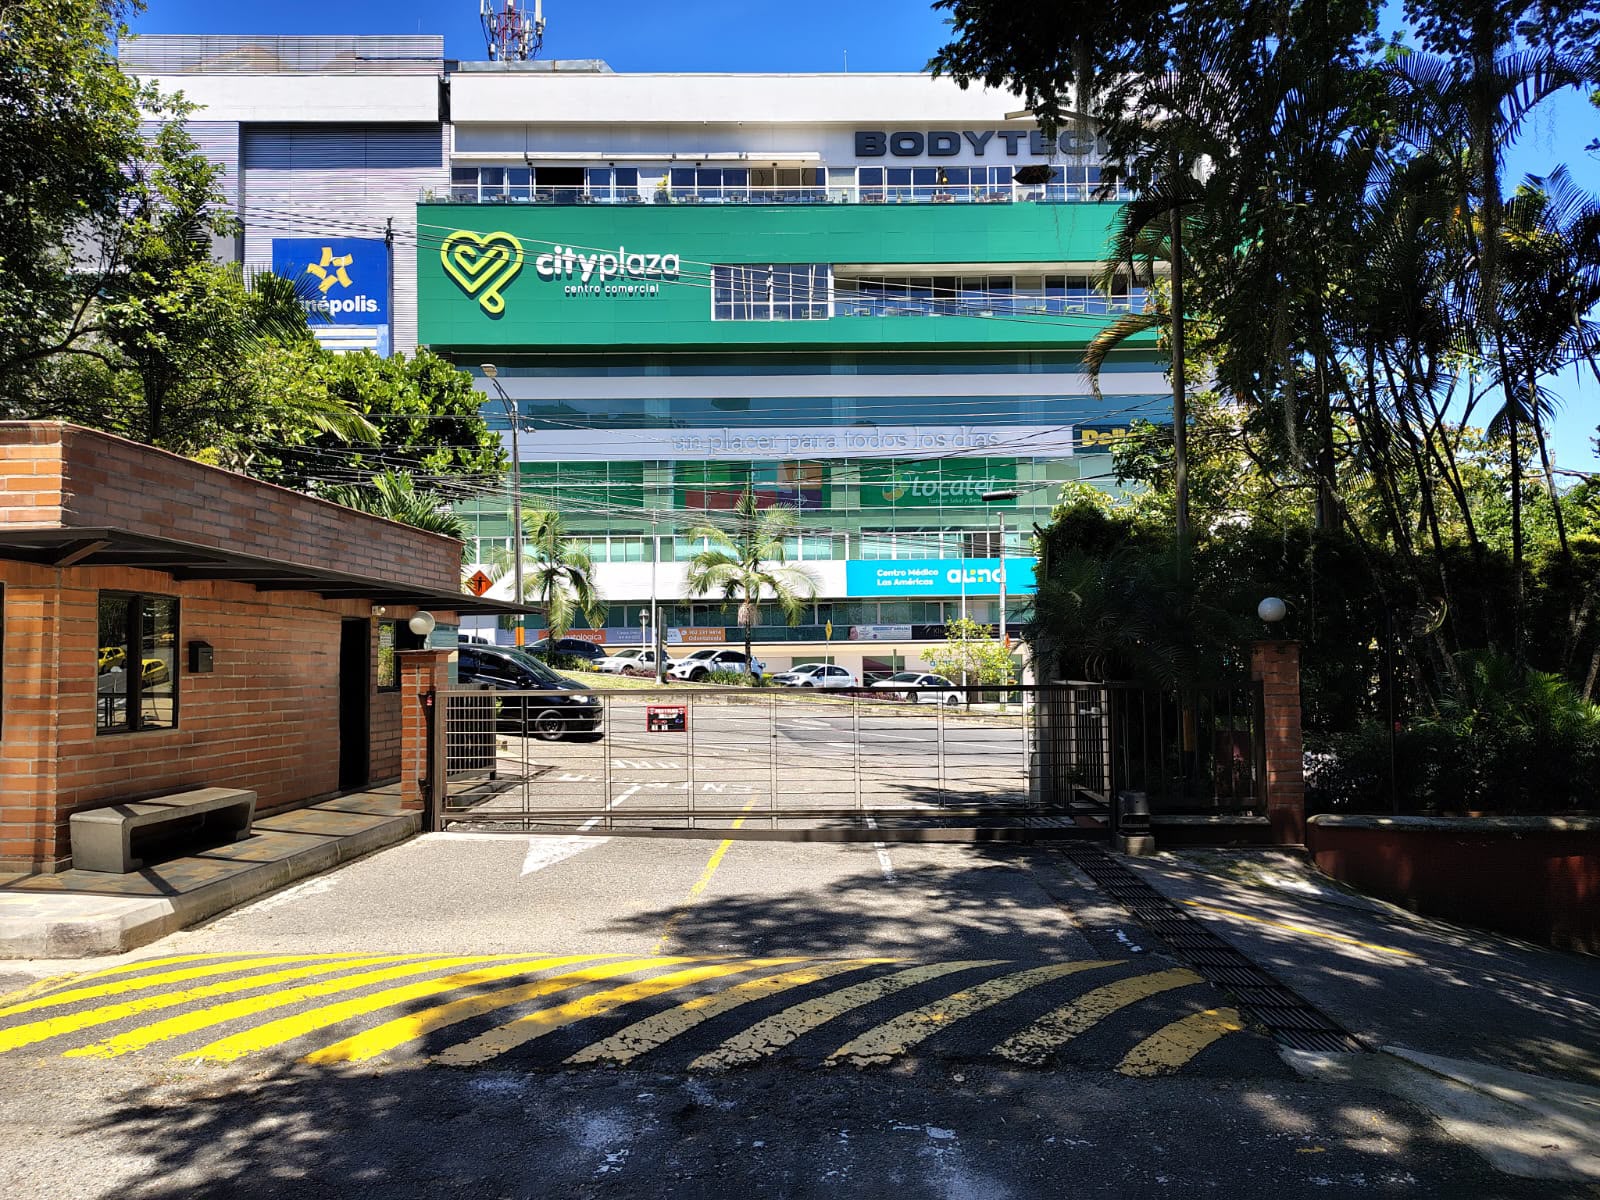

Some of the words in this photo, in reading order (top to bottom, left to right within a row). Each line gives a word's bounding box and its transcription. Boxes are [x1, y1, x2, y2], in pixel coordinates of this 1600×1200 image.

[536, 246, 680, 282] cityplaza
[564, 284, 600, 293] centro
[604, 284, 659, 293] comercial
[672, 433, 701, 450] un
[707, 428, 780, 456] placer
[785, 432, 838, 456] para
[845, 427, 907, 448] todos
[914, 427, 947, 448] los
[953, 426, 1000, 447] días
[911, 475, 996, 496] Locatel
[908, 568, 939, 576] Médico
[894, 578, 934, 586] Américas
